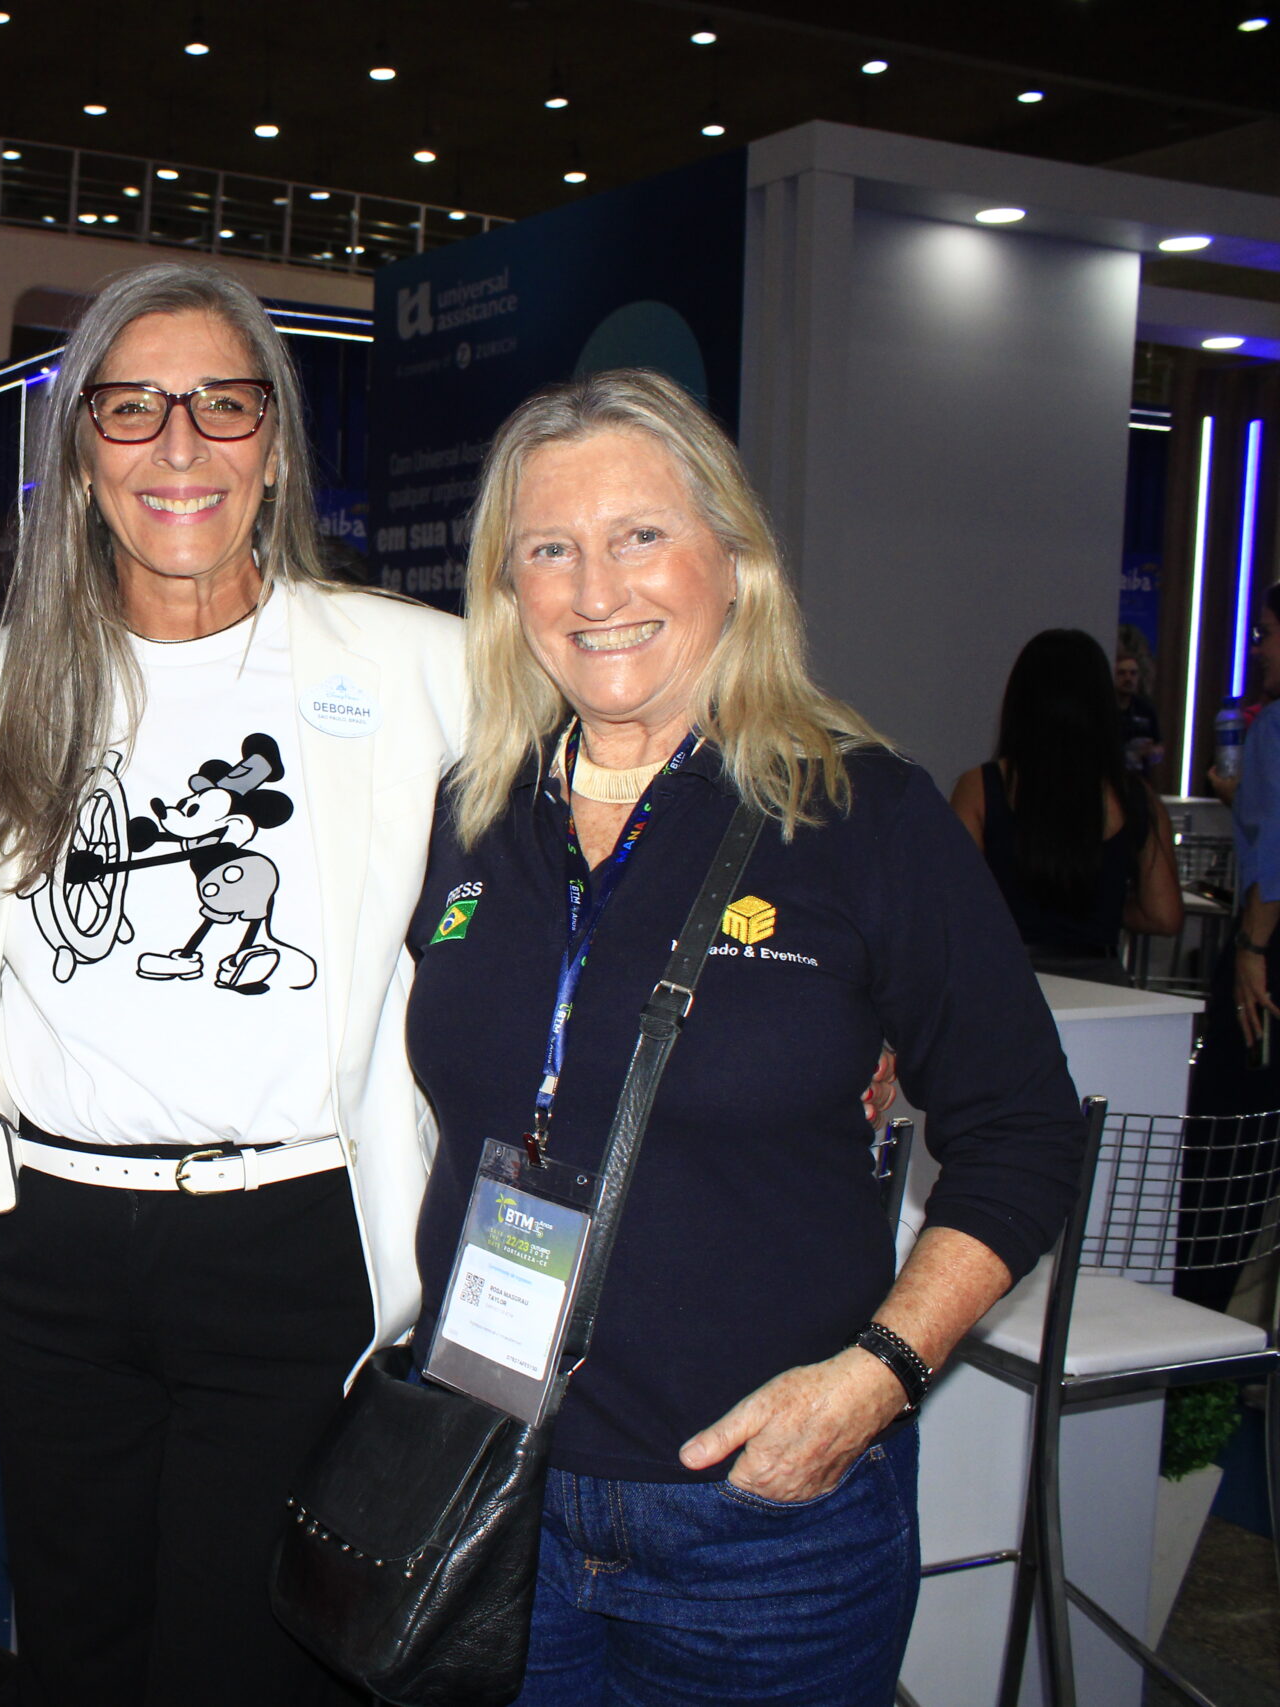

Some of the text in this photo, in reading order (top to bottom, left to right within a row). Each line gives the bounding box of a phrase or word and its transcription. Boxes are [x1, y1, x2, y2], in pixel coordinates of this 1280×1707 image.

[437, 266, 509, 308] universal
[436, 293, 518, 331] assistance
[476, 336, 518, 359] ZURICH
[377, 526, 406, 553] em
[409, 521, 447, 550] sua
[381, 563, 402, 592] te
[313, 701, 371, 718] DEBORAH
[743, 945, 755, 958] &
[760, 947, 819, 967] Eventos
[505, 1208, 535, 1231] BTM
[505, 1234, 530, 1252] 22/23
